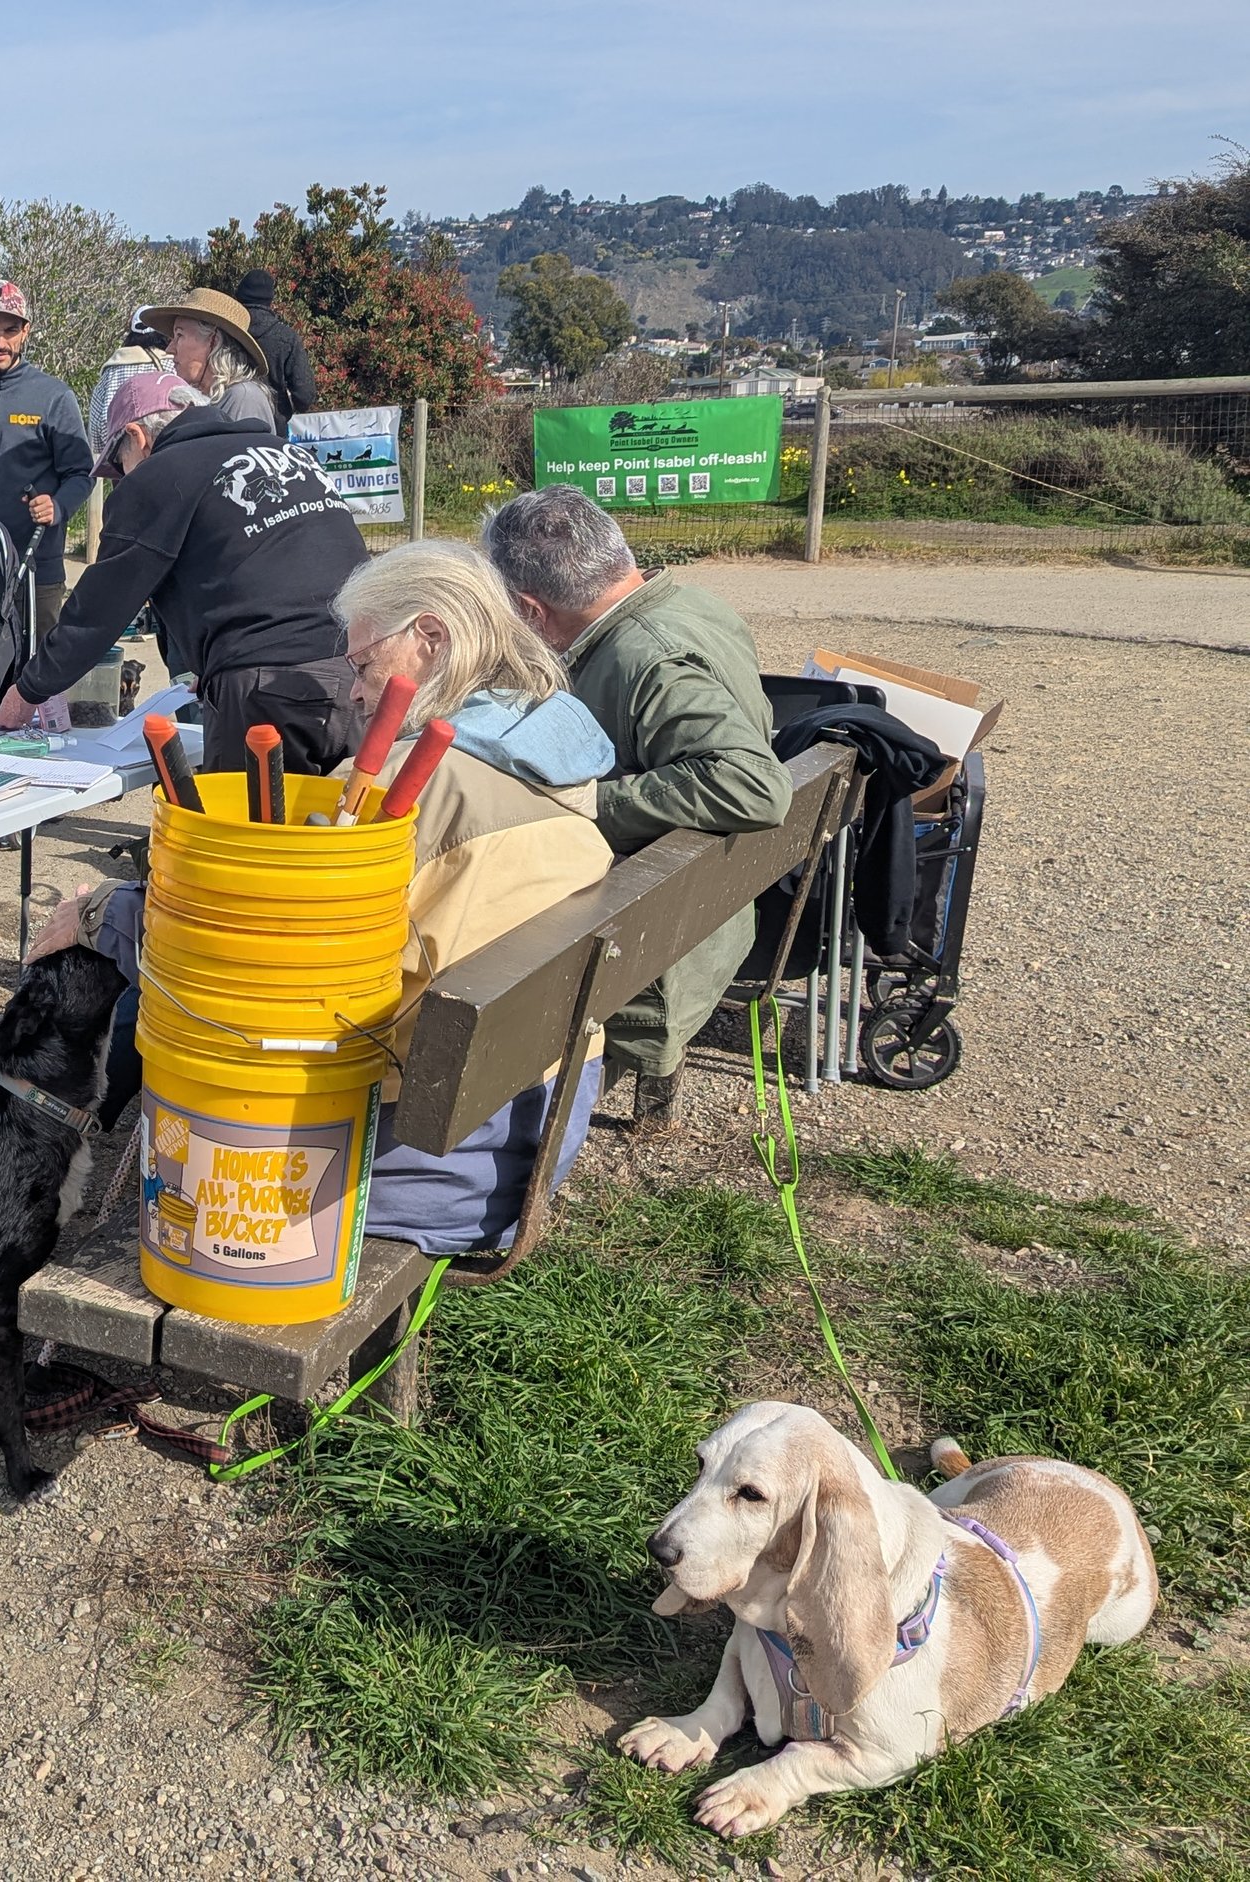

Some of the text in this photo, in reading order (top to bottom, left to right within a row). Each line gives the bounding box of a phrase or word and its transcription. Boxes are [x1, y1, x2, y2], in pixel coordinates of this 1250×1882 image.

[9, 413, 42, 426] BOLT
[610, 435, 699, 447] Point Isabel Dog Owners
[546, 450, 767, 475] Help keep Point Isabel off-leash!
[347, 472, 399, 488] Owners
[367, 501, 392, 516] 1985
[244, 523, 263, 539] Pt.
[263, 504, 299, 528] Isabel
[300, 499, 325, 513] Dog
[369, 1084, 380, 1123] park
[158, 1115, 173, 1132] THE
[155, 1117, 189, 1153] HOME
[165, 1138, 189, 1158] DEPOT
[211, 1147, 309, 1184] HOMER'S
[206, 1211, 288, 1245] BUCKET
[213, 1243, 266, 1261] 5 Gallons
